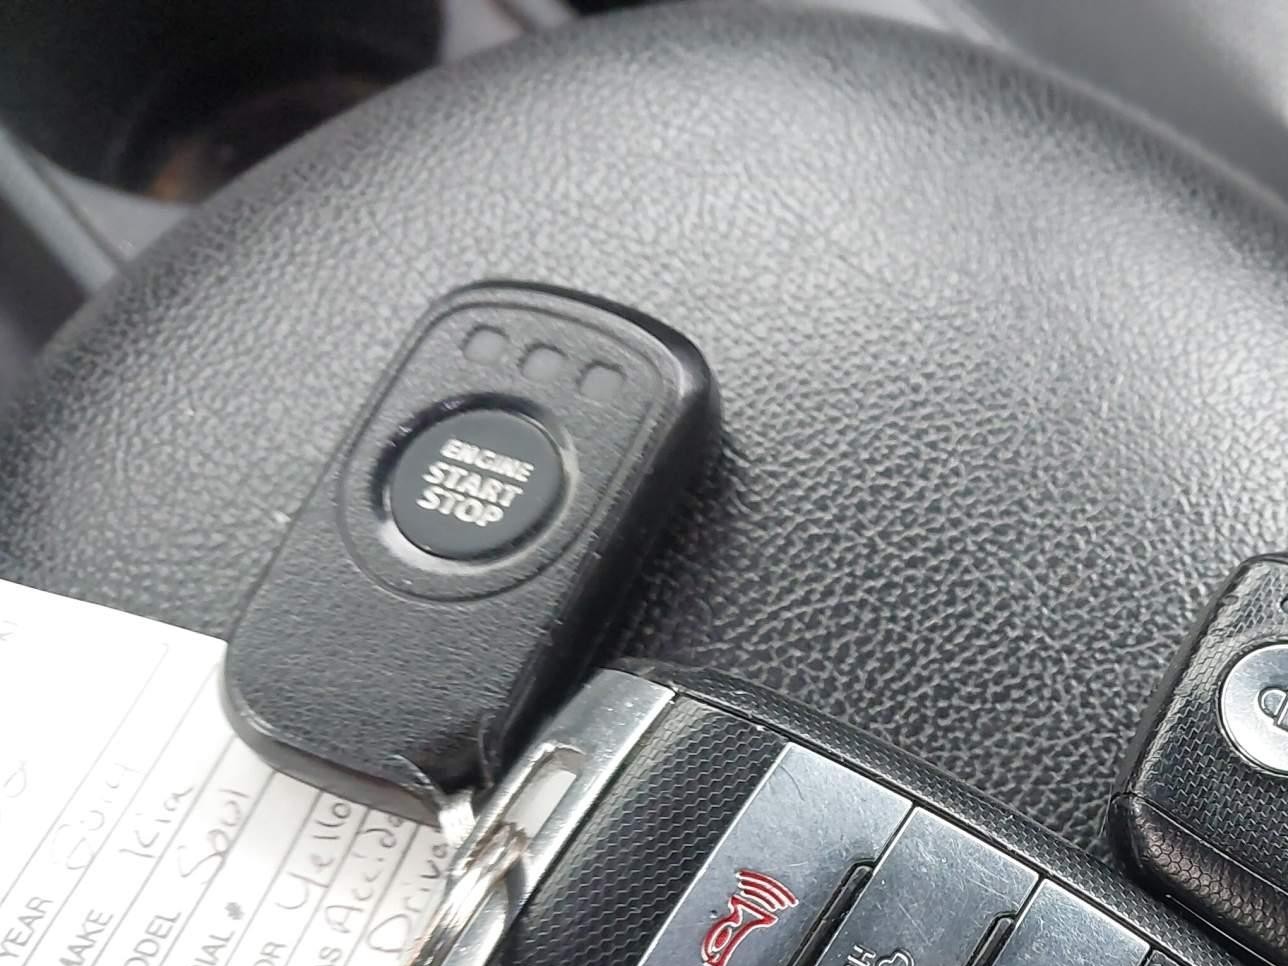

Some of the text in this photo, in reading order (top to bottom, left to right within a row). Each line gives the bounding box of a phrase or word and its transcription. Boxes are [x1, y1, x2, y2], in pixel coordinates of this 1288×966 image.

[421, 461, 524, 508] START
[440, 438, 534, 482] ENGINE
[416, 485, 505, 527] STOP
[118, 785, 195, 859] Kia
[176, 787, 251, 884] Soul
[0, 896, 54, 959] YEAR
